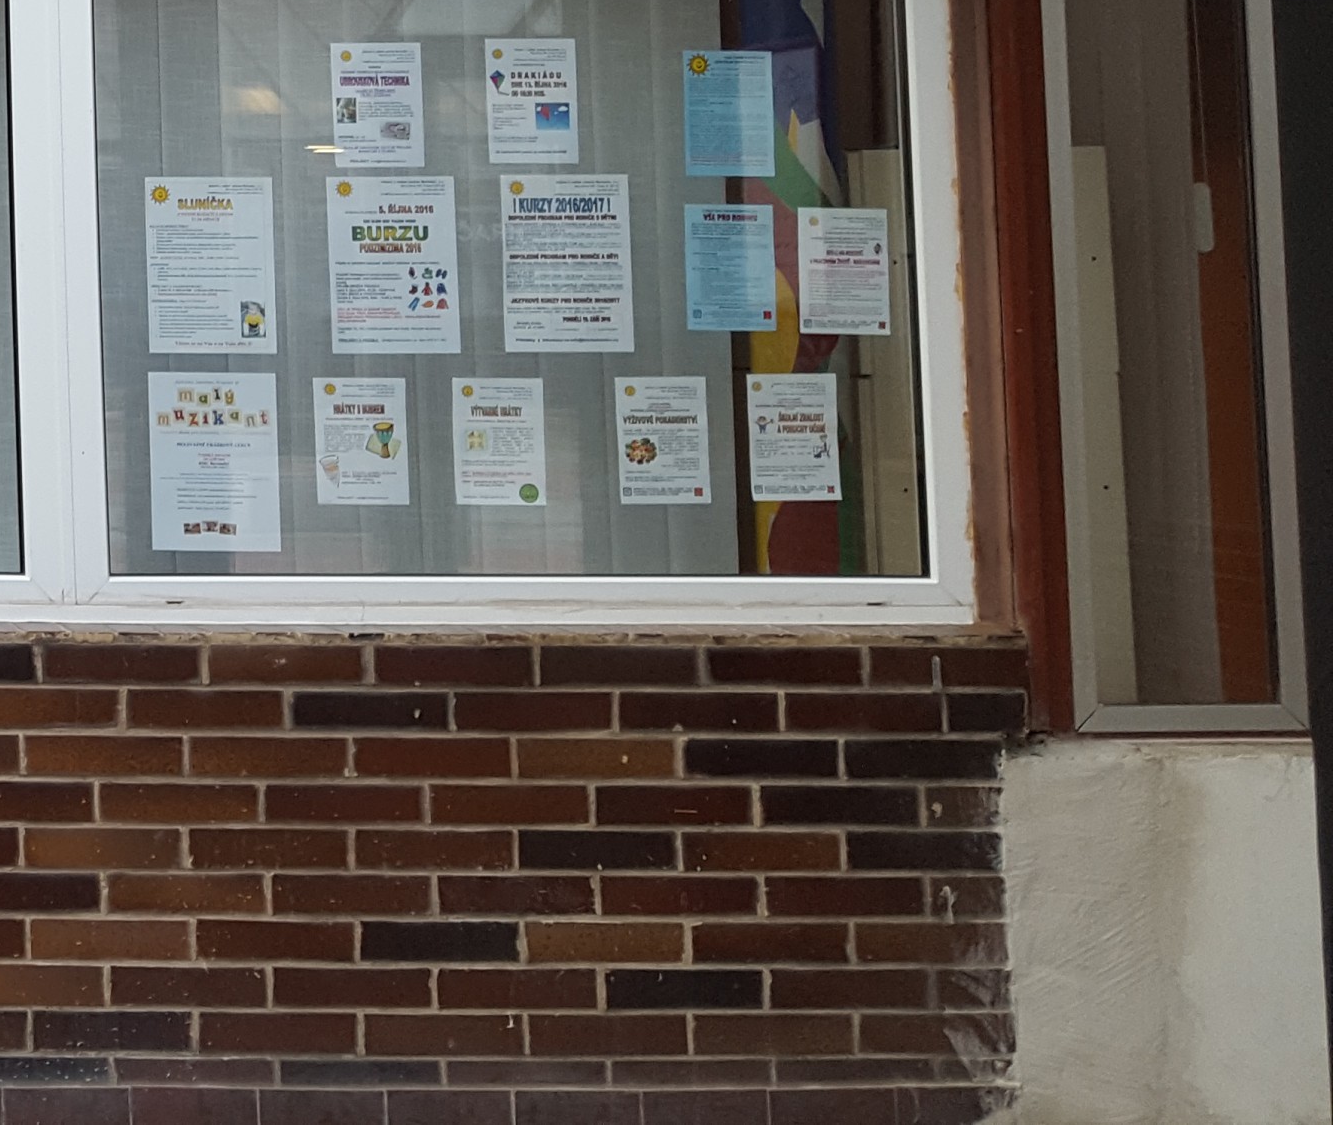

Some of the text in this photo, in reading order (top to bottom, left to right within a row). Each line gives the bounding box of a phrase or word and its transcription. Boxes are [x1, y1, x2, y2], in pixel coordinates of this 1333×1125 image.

[177, 196, 234, 211] SLUNÍČKA
[387, 203, 413, 214] ŘÍJNA
[414, 205, 434, 214] 2016
[518, 197, 553, 213] KURZY
[554, 197, 605, 213] 2016/2017
[351, 225, 429, 242] BURZU
[158, 409, 268, 427] muzikant
